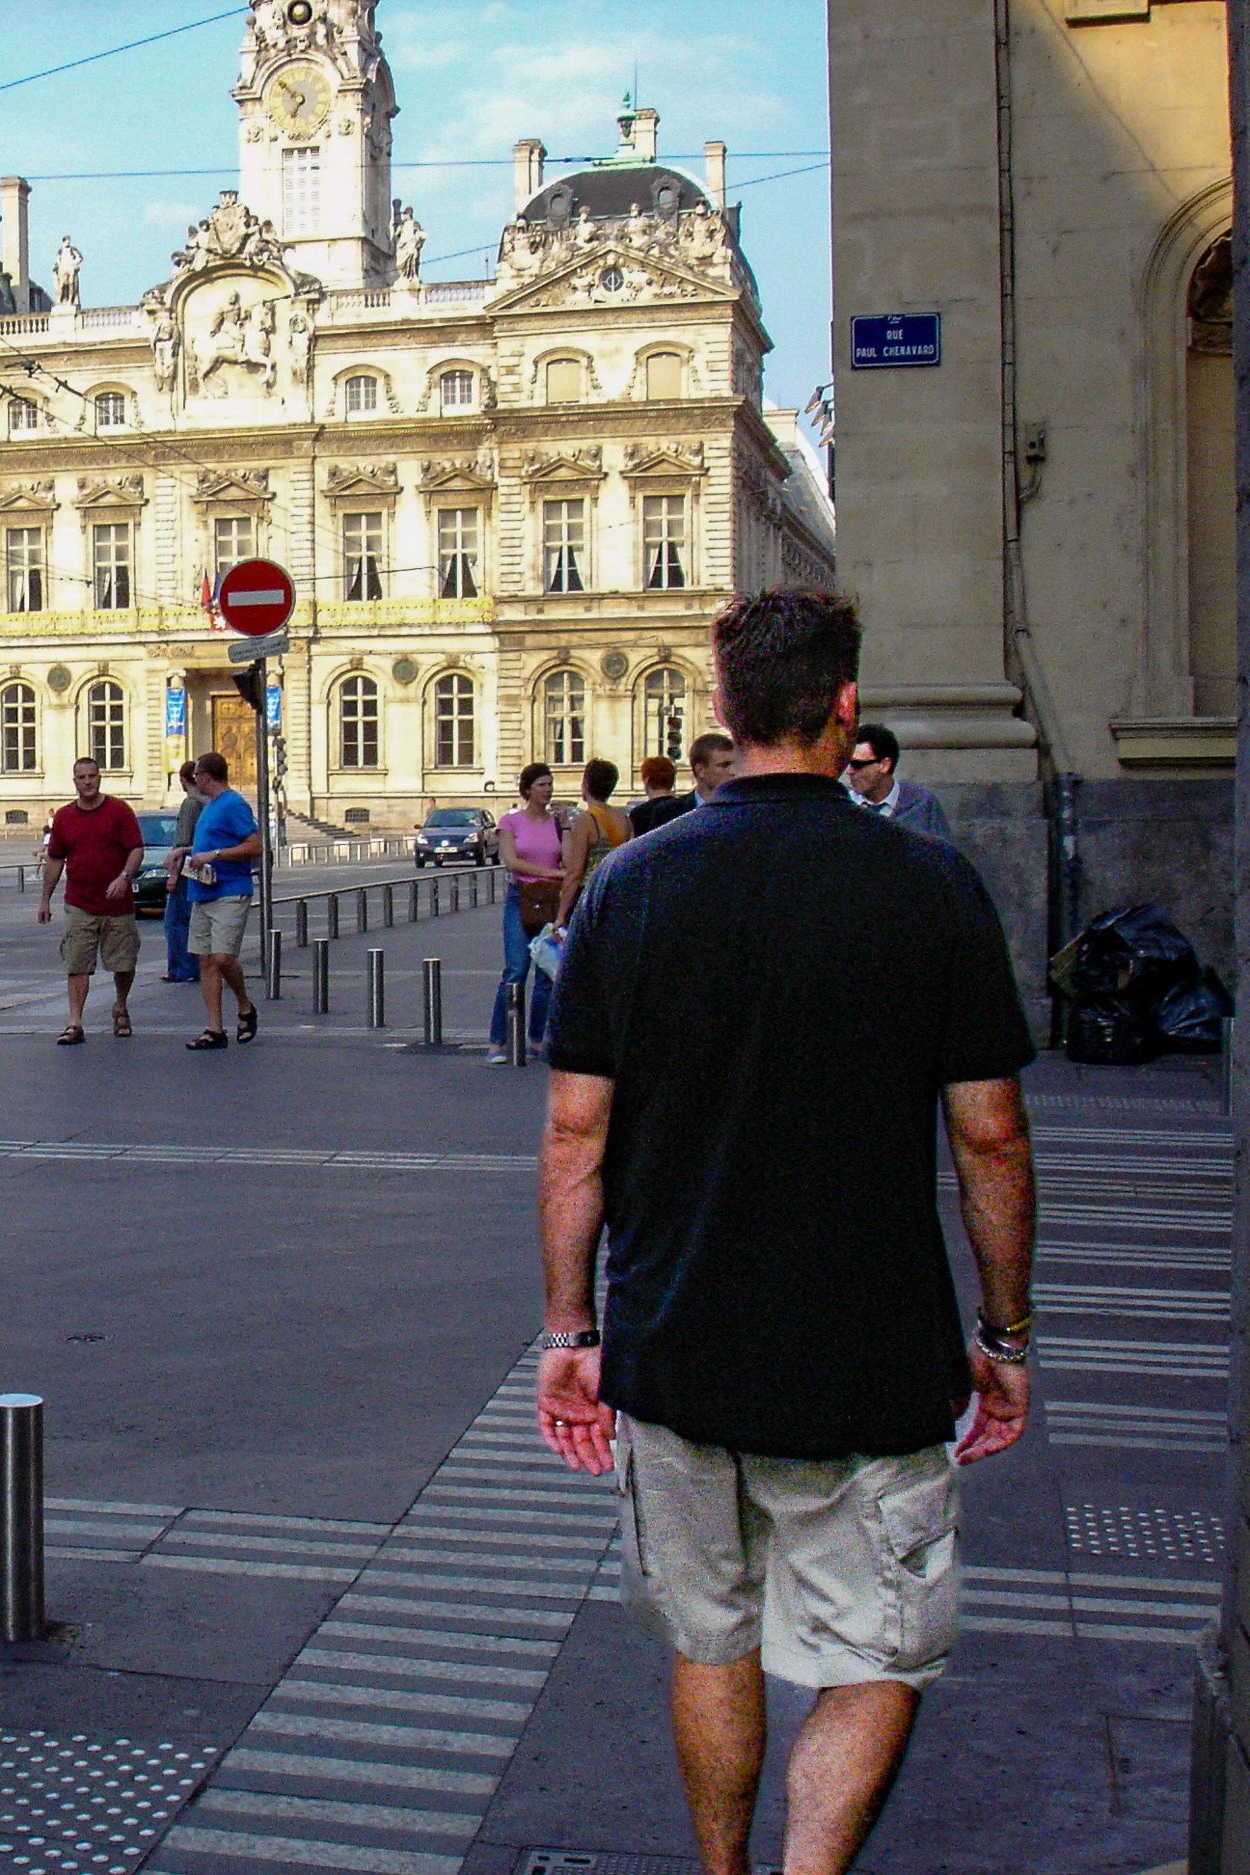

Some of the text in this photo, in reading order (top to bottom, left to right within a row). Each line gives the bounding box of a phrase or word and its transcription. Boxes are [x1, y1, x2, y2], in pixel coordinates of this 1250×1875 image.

[886, 329, 904, 340] RUE
[856, 344, 935, 358] PAUL CHENAVARD
